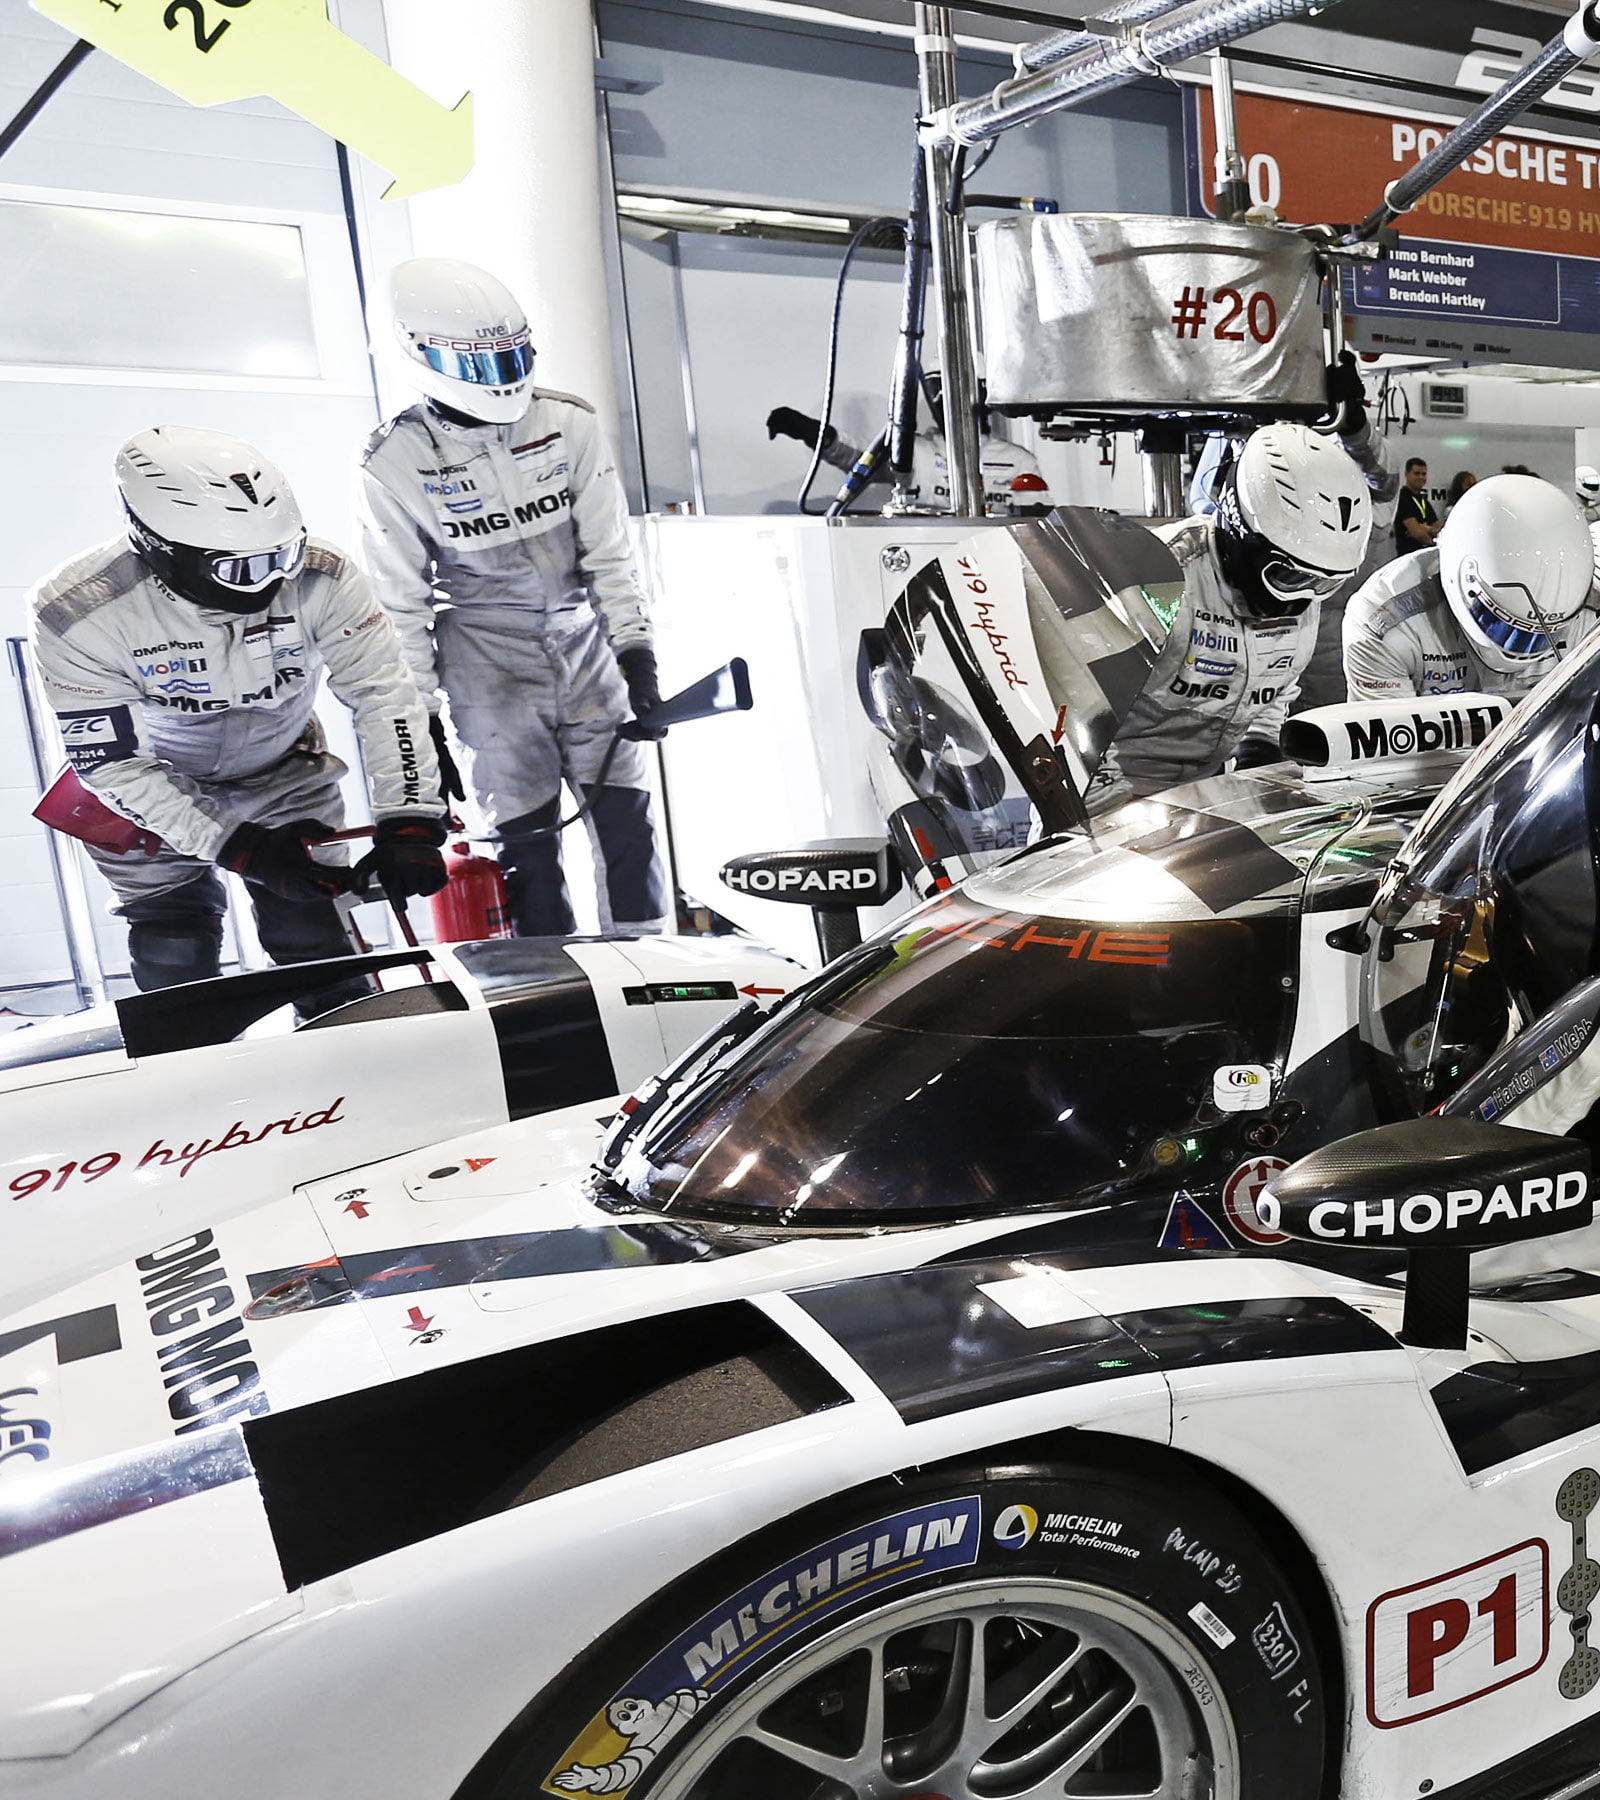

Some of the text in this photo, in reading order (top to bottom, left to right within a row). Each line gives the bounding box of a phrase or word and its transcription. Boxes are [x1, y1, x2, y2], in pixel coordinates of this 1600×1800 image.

[1391, 124, 1568, 186] POSCHE
[1413, 191, 1523, 225] PORSCHE
[1529, 206, 1572, 231] 919
[1388, 267, 1467, 287] Mark Webber
[1421, 250, 1475, 268] Bernhard
[1171, 286, 1277, 344] #20
[1389, 287, 1486, 311] Brendon Hartley
[429, 334, 531, 352] PORSC
[475, 324, 511, 339] uve
[133, 643, 169, 658] DMG
[970, 601, 1028, 691] hybrid
[1169, 676, 1230, 700] DMG
[1363, 680, 1402, 690] vodafone
[1344, 706, 1503, 761] Mobil 1
[1493, 1066, 1538, 1111] Hartley
[8, 1096, 346, 1202] 919 hybrid
[1307, 1170, 1589, 1238] CHOPARD
[135, 1228, 236, 1337] DMG
[1039, 1530, 1141, 1560] Total Performance
[1044, 1512, 1123, 1538] MICHELIN
[684, 1511, 971, 1682] MICHELIN
[1263, 1623, 1294, 1669] 2301
[1407, 1572, 1518, 1699] P1
